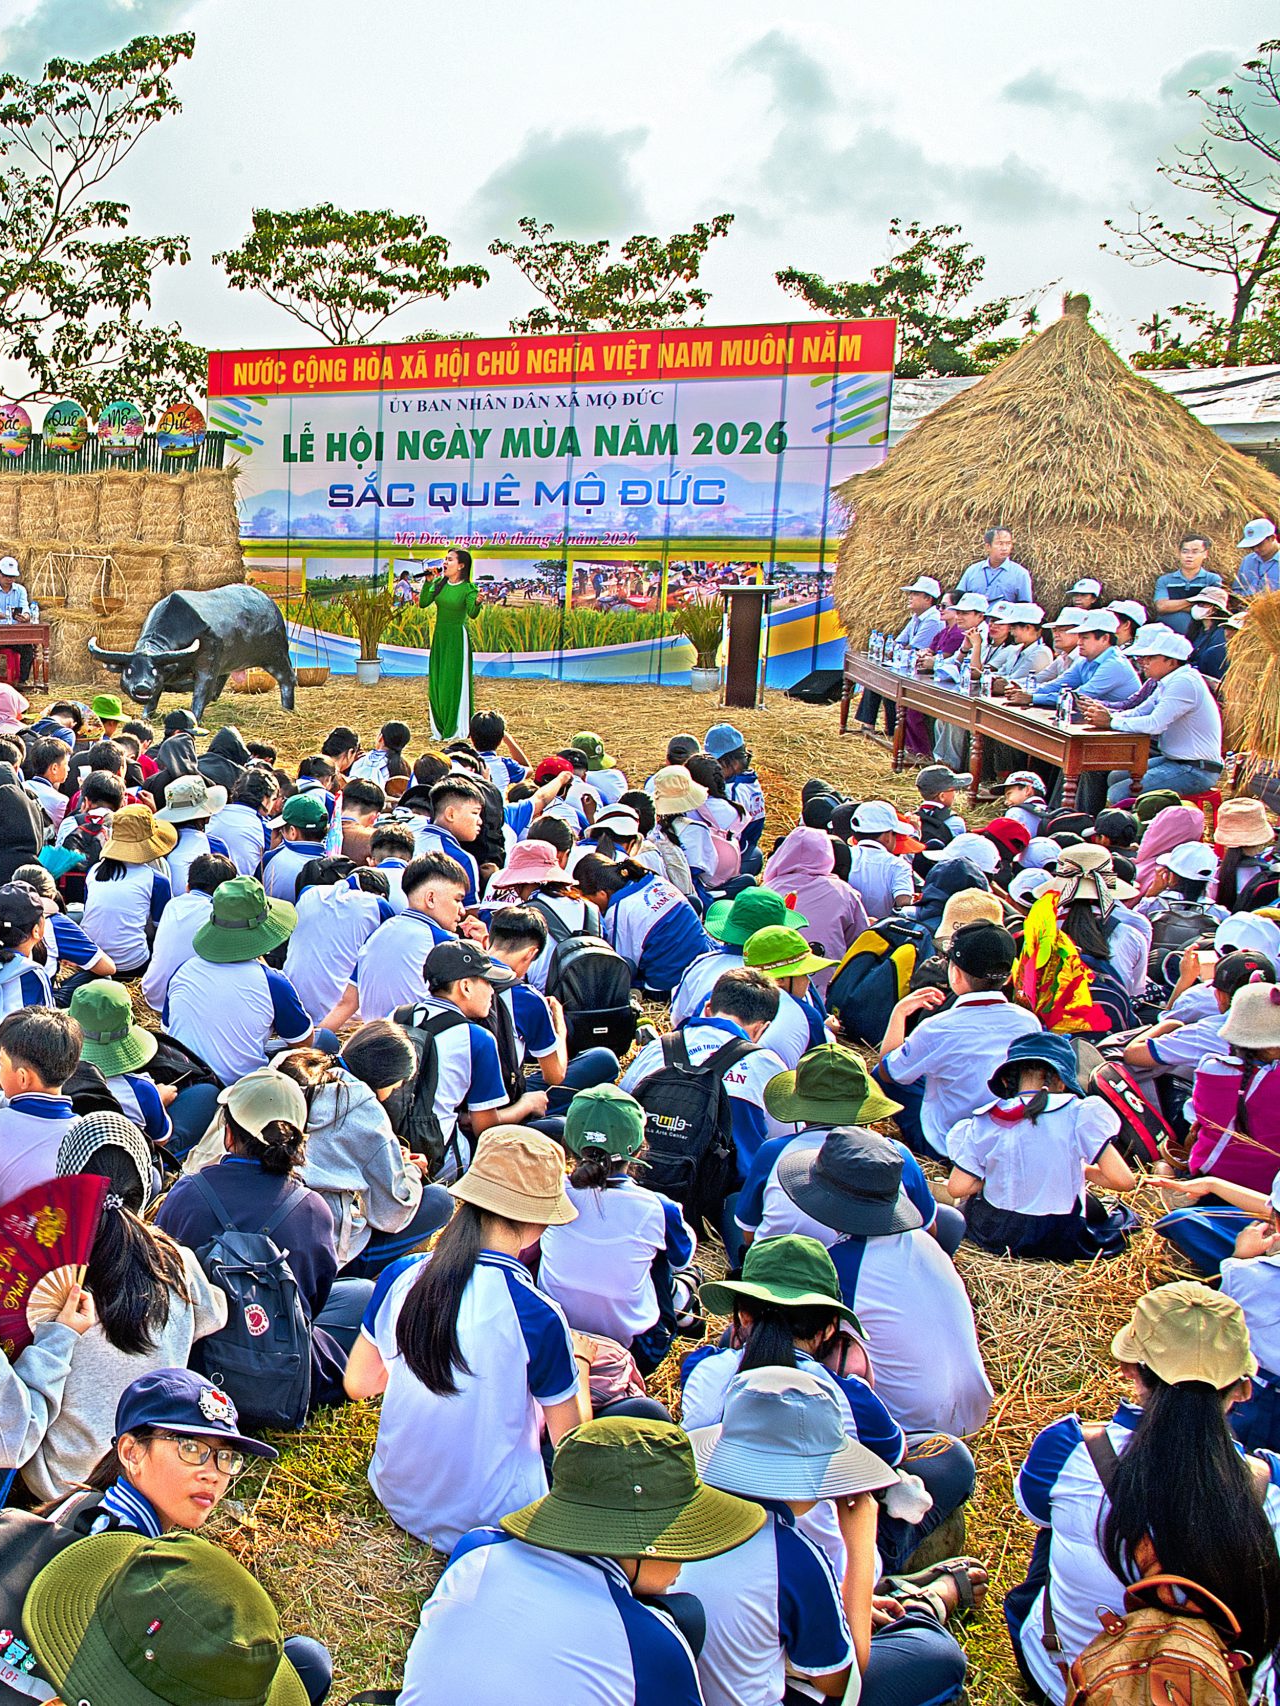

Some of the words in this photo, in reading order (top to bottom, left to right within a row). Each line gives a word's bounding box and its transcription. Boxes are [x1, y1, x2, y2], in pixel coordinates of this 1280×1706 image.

[233, 356, 286, 386] NƯỚC
[293, 354, 347, 388] CỘNG
[353, 353, 393, 381] HÒA
[400, 351, 427, 379] XÃ
[435, 348, 469, 382] HỘI
[477, 342, 519, 375] CHỦ
[527, 342, 595, 374] NGHĨA
[602, 339, 651, 375] VIỆT
[658, 341, 712, 369] NAM
[720, 333, 794, 366] MUÔN
[802, 330, 861, 363] NĂM
[389, 390, 412, 413] ỦY
[417, 398, 451, 412] BAN
[457, 393, 506, 411] NHÂN
[513, 391, 549, 409] DÂN
[555, 390, 579, 408] XÃ
[586, 391, 617, 409] MỘ
[622, 388, 664, 406] ĐỨC
[48, 406, 80, 427] Quê
[108, 407, 130, 433] Mộ
[160, 406, 190, 434] Đức
[282, 421, 314, 463] LỄ
[326, 425, 383, 470] HỘI
[397, 422, 492, 460] NGÀY
[500, 419, 581, 458] MÙA
[594, 418, 678, 457] NĂM
[691, 421, 788, 456] 2026
[328, 471, 415, 508] SẮC
[428, 473, 520, 513] QUÊ
[534, 471, 607, 515] MỘ
[618, 470, 727, 507] ĐỨC
[393, 532, 415, 547] Mộ
[418, 531, 451, 547] Đức,
[453, 533, 487, 548] ngày
[490, 532, 506, 546] 18
[509, 532, 551, 547] tháng
[553, 532, 563, 546] 4
[567, 533, 598, 546] năm
[602, 532, 637, 546] 2026
[723, 1070, 747, 1084] ÀN
[0, 1666, 19, 1682] LOF
